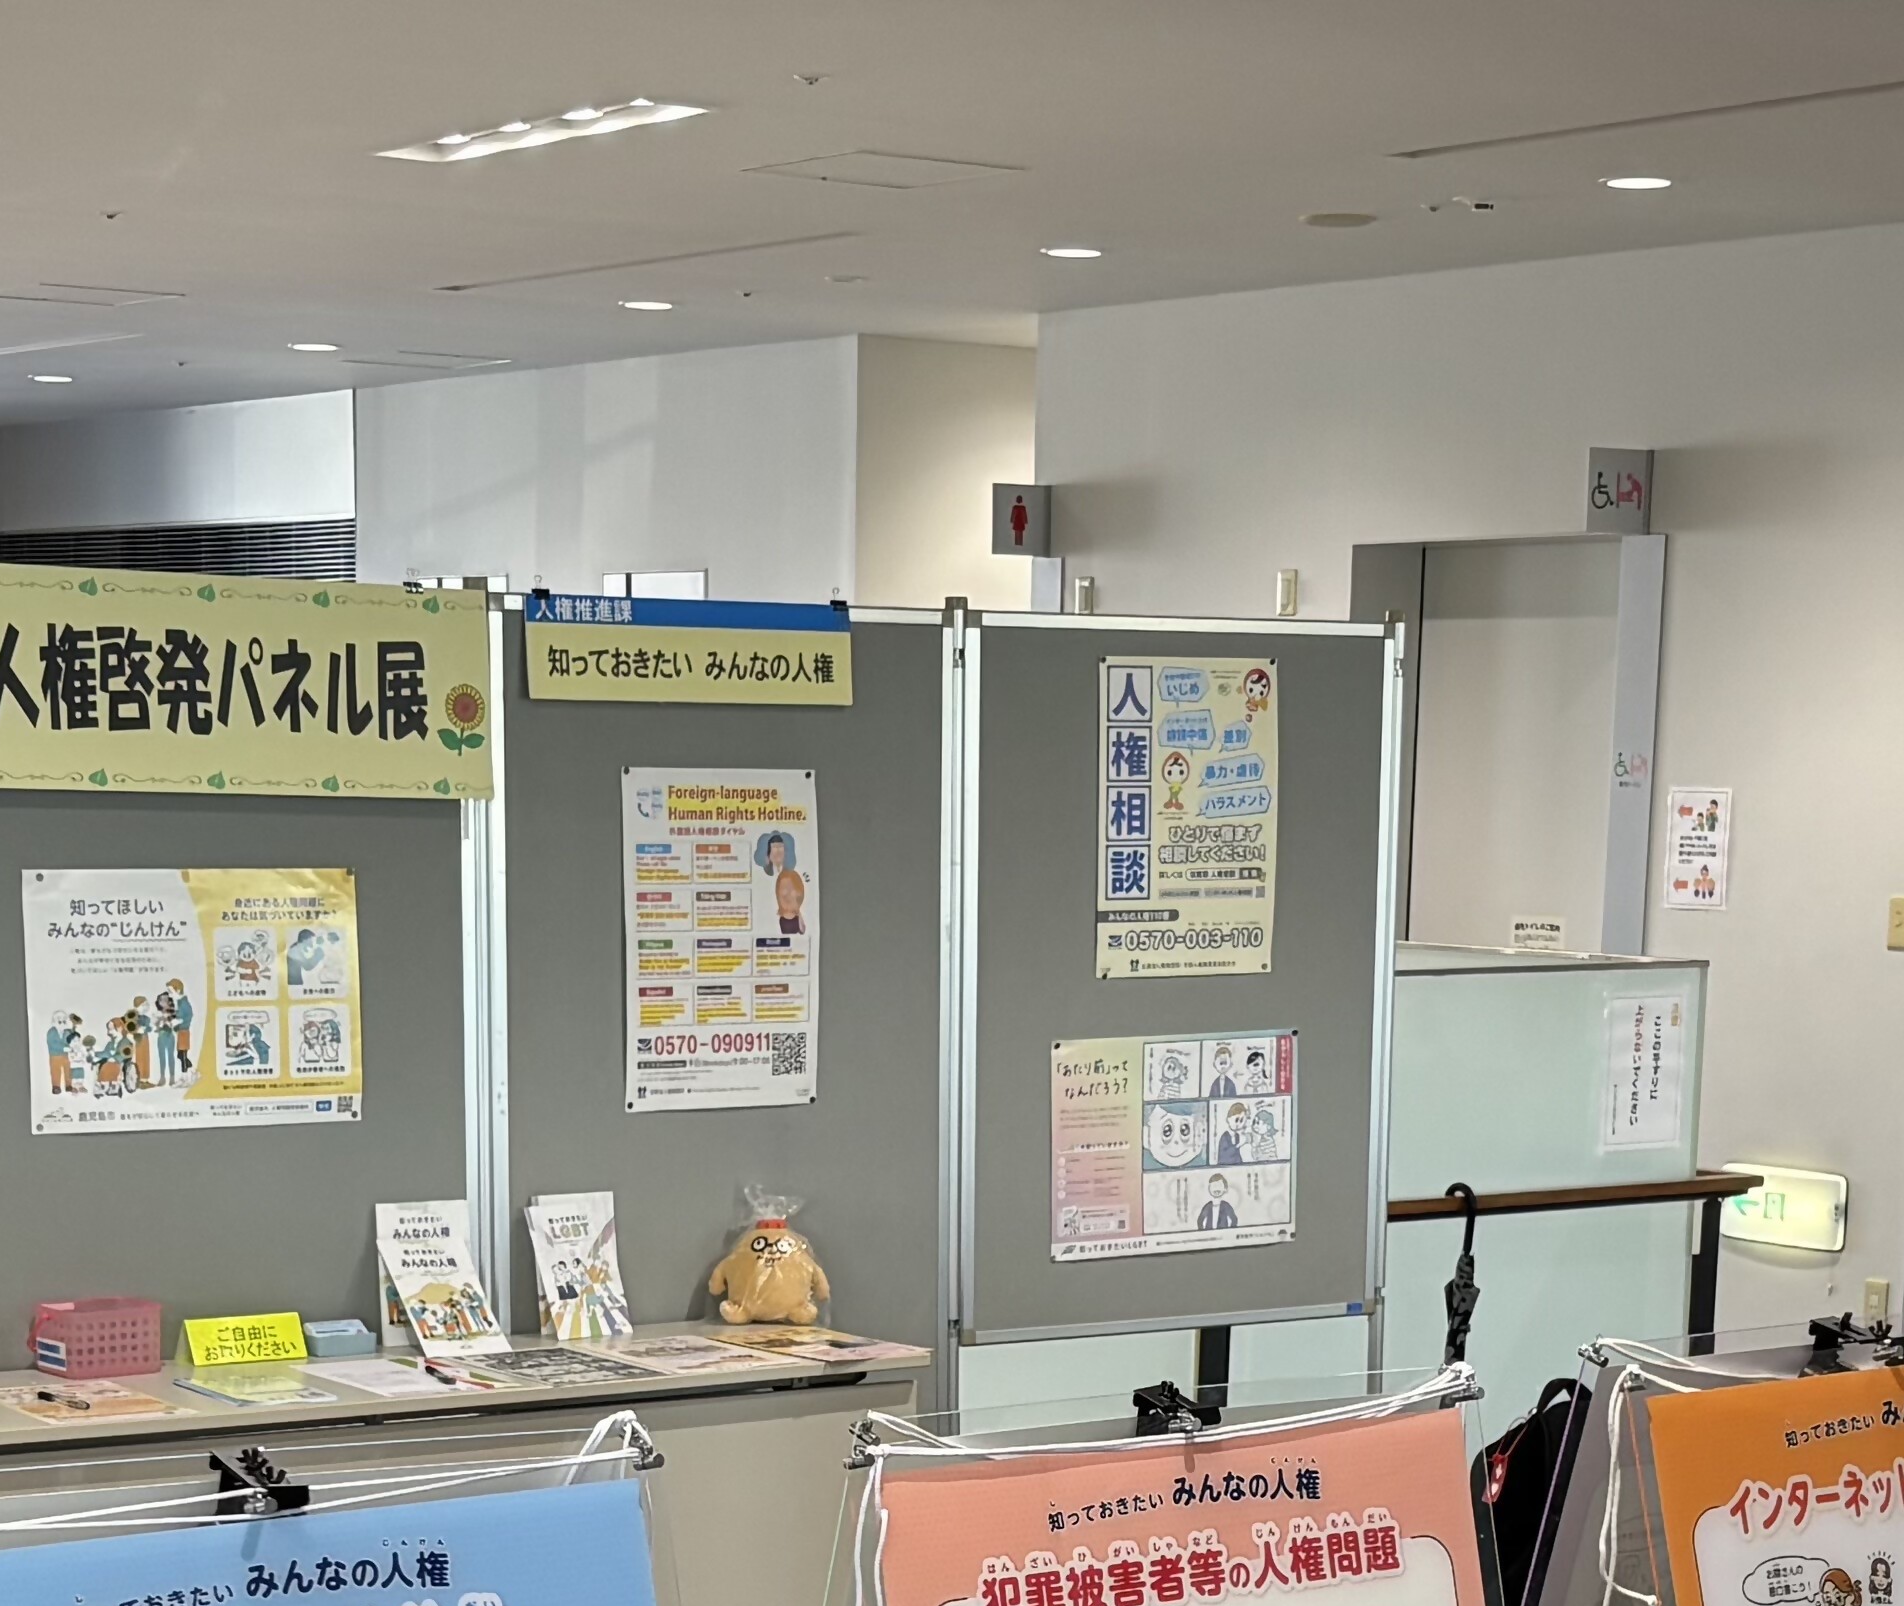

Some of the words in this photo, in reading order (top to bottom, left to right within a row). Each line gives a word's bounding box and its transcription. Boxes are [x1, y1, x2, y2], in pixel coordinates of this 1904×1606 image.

[535, 598, 632, 622] 人権推進課
[548, 644, 692, 678] 知っておきたい
[705, 651, 834, 684] みんなの人権
[668, 785, 778, 801] Foreign-language
[1110, 671, 1149, 897] 人権相談
[1205, 791, 1266, 810] ハラスメント
[669, 807, 714, 822] Human
[716, 807, 755, 823] Rights
[70, 899, 164, 917] 知ってほしい
[1125, 927, 1263, 951] 0570-003-110
[655, 1032, 771, 1055] 0570-090911
[551, 1223, 589, 1239] LGBT
[216, 1324, 277, 1343] ご自由に
[1785, 1414, 1875, 1448] 知っておきたい
[1048, 1491, 1166, 1532] 知っておきたい
[1172, 1468, 1321, 1505] みんなの人権
[245, 1549, 451, 1600] みんなの人権
